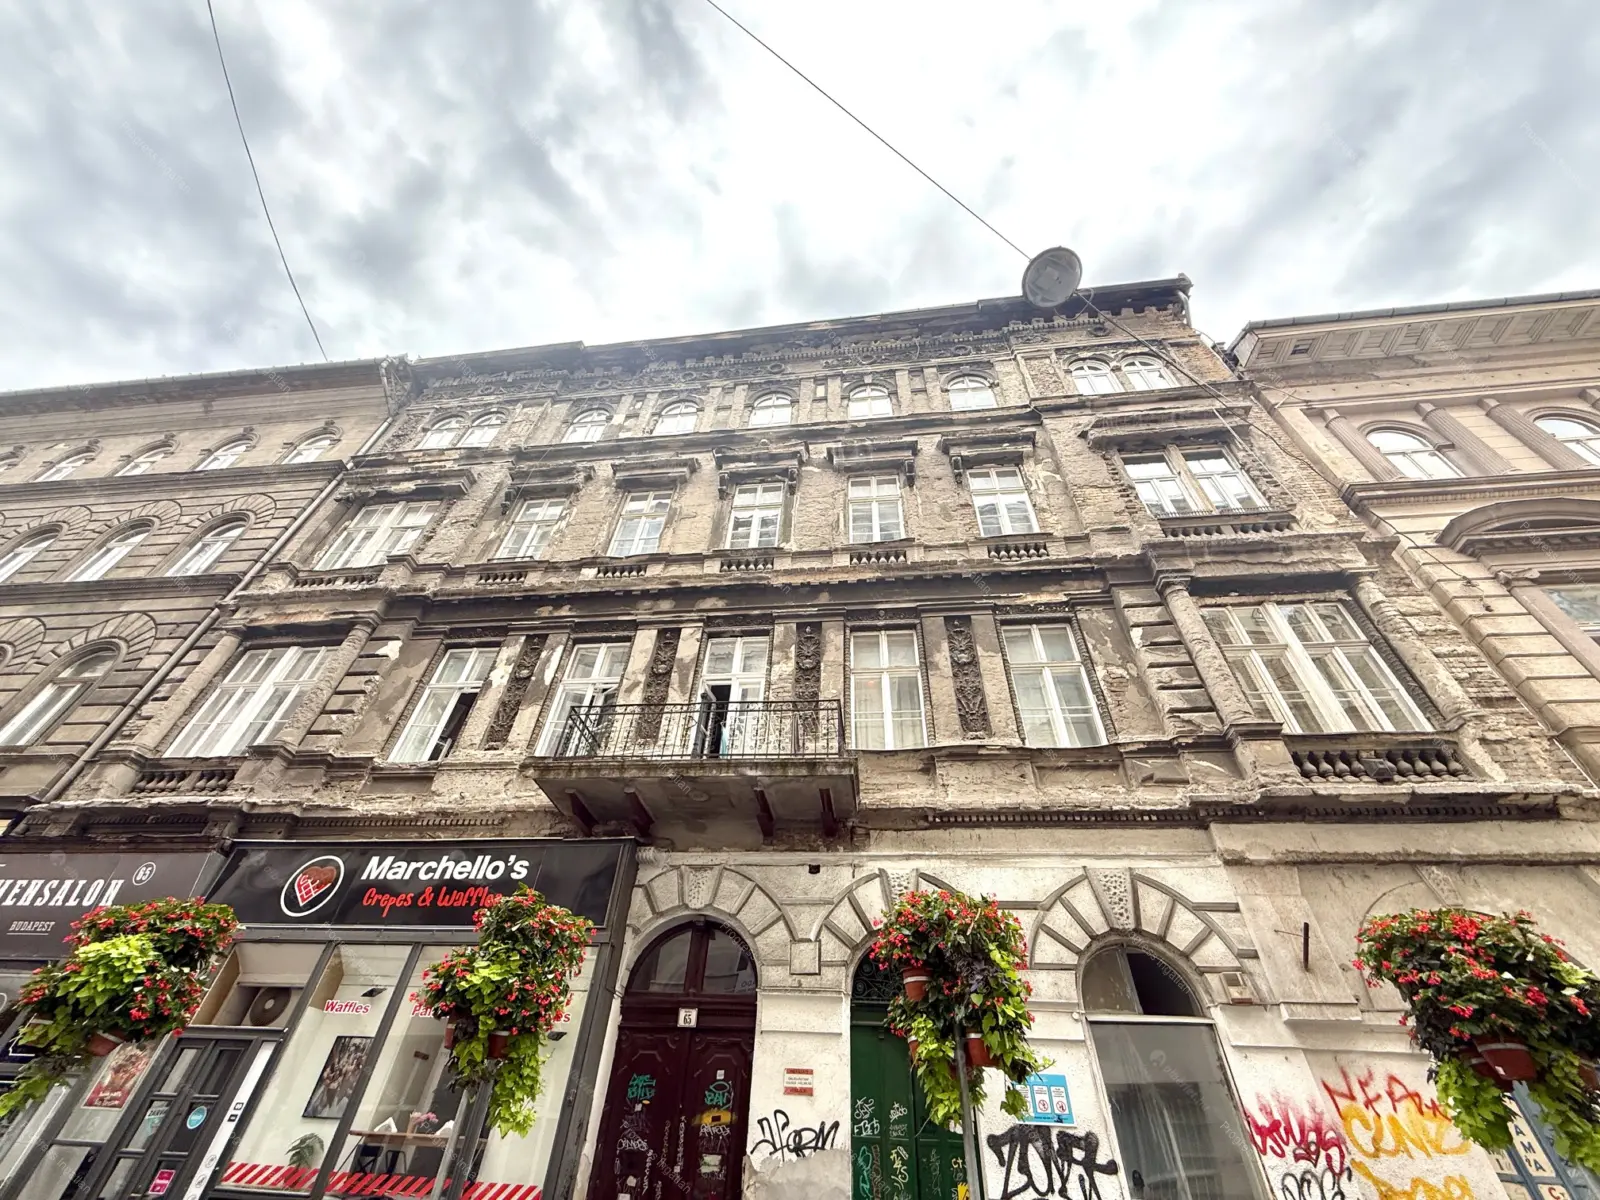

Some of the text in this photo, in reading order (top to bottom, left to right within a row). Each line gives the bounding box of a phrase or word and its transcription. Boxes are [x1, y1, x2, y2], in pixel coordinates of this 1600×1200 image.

[135, 866, 153, 881] 65
[360, 855, 530, 881] Marchello's
[362, 887, 415, 918] Crepes
[417, 886, 435, 907] &
[8, 920, 56, 932] BUDAPEST
[324, 999, 371, 1015] Waffles
[683, 1013, 692, 1025] 65
